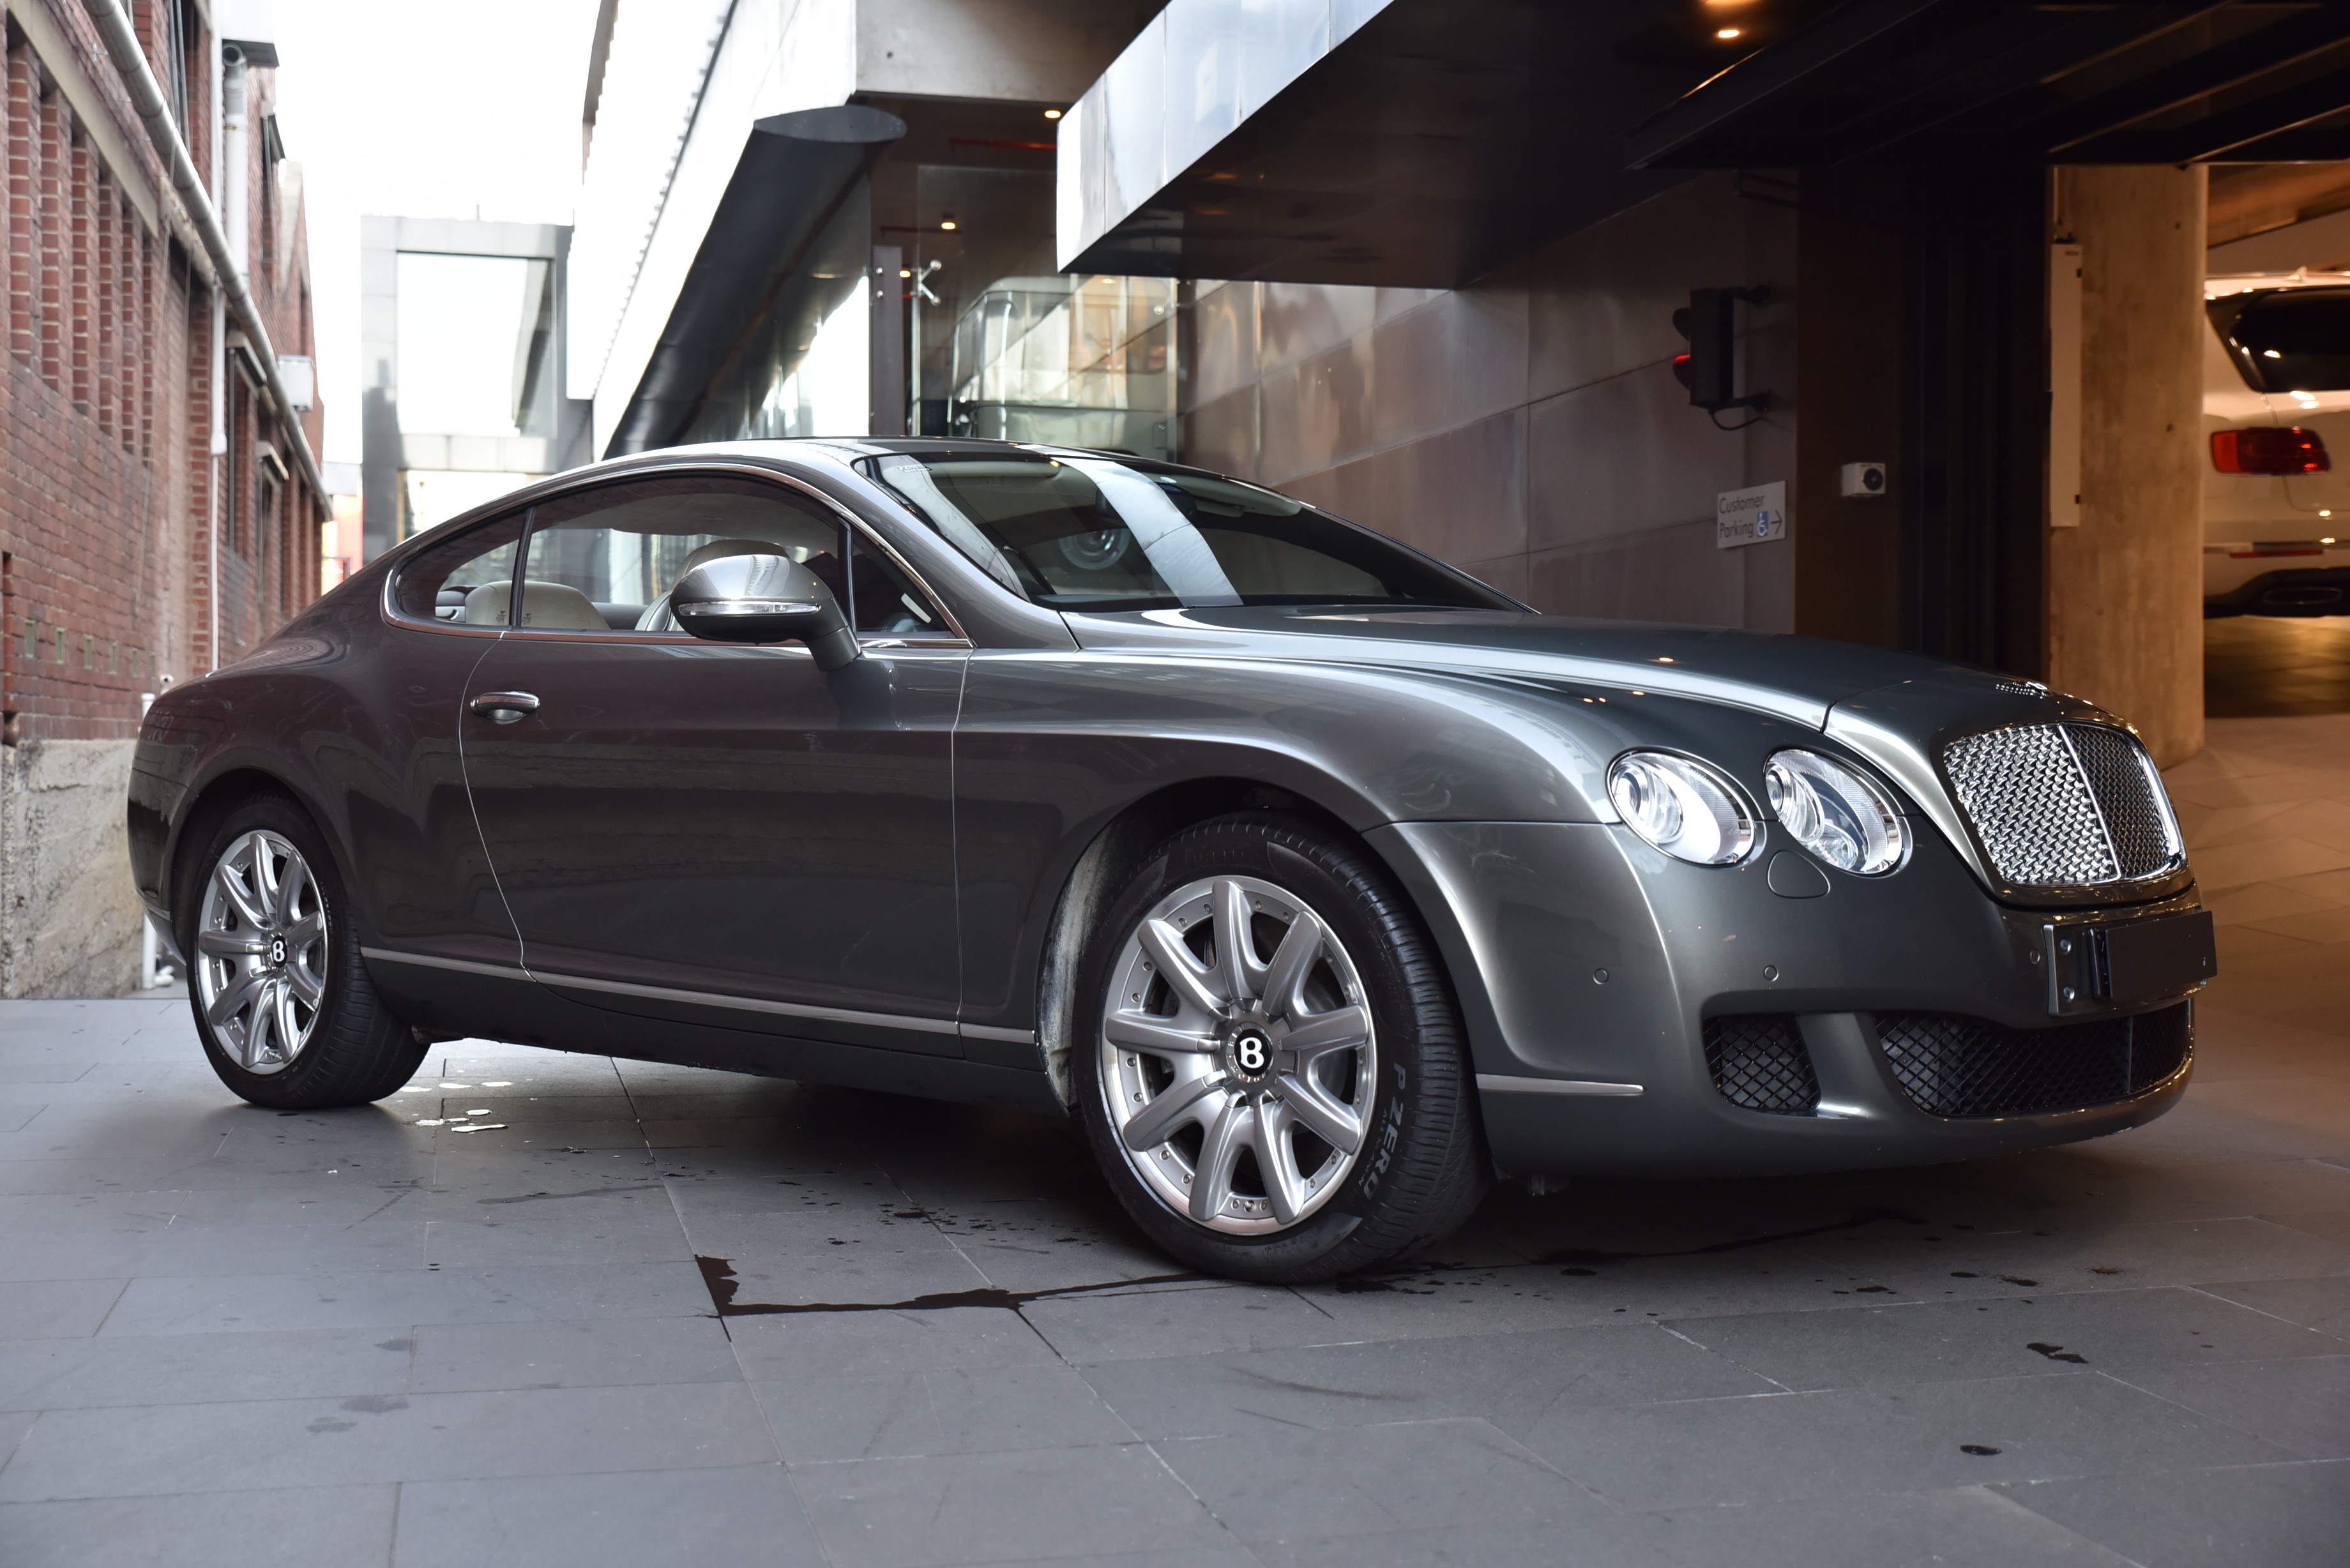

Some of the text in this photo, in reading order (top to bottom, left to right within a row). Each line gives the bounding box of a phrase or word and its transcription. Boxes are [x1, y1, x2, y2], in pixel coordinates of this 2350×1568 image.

[1719, 495, 1764, 514] Customer
[1719, 520, 1754, 539] Parking
[273, 940, 285, 962] B
[1239, 1037, 1264, 1069] B
[1363, 1062, 1406, 1201] P ZERO
